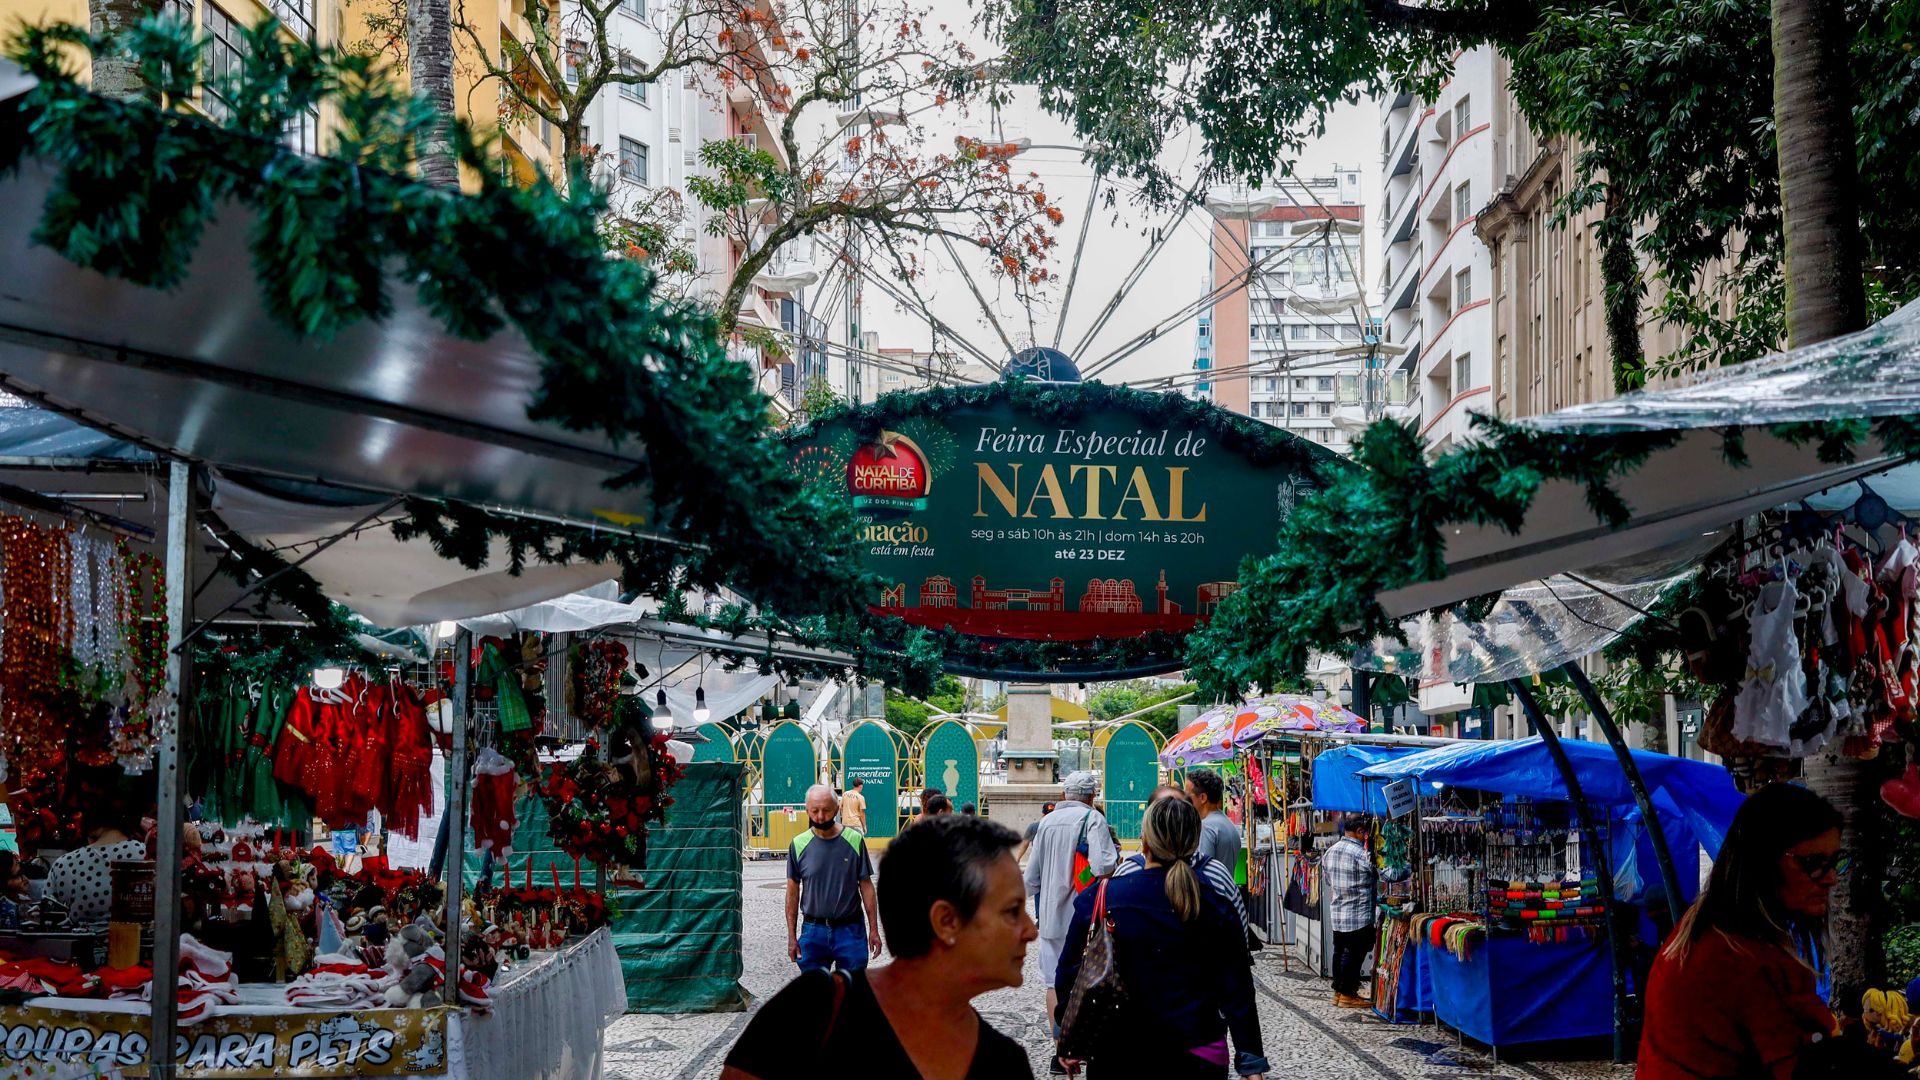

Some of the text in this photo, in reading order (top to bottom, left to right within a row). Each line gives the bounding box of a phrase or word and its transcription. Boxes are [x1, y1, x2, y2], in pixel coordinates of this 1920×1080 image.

[974, 426, 1206, 459] Feira Especial de
[854, 477, 918, 491] CURITIBA
[973, 462, 1206, 522] NATAL
[856, 521, 928, 545] oração
[971, 528, 994, 542] seg
[997, 530, 1005, 539] a
[1008, 528, 1031, 539] sáb
[1033, 529, 1054, 540] 10h
[1058, 529, 1072, 540] às
[1074, 529, 1095, 541] 21h
[1105, 530, 1135, 542] dom
[1138, 531, 1160, 542] 14h
[1163, 531, 1178, 543] às
[1180, 532, 1205, 544] 20h
[871, 544, 935, 558] está em festa
[1054, 549, 1125, 561] até 23 DEZ
[848, 770, 892, 779] presentear
[288, 1028, 396, 1066] PETS
